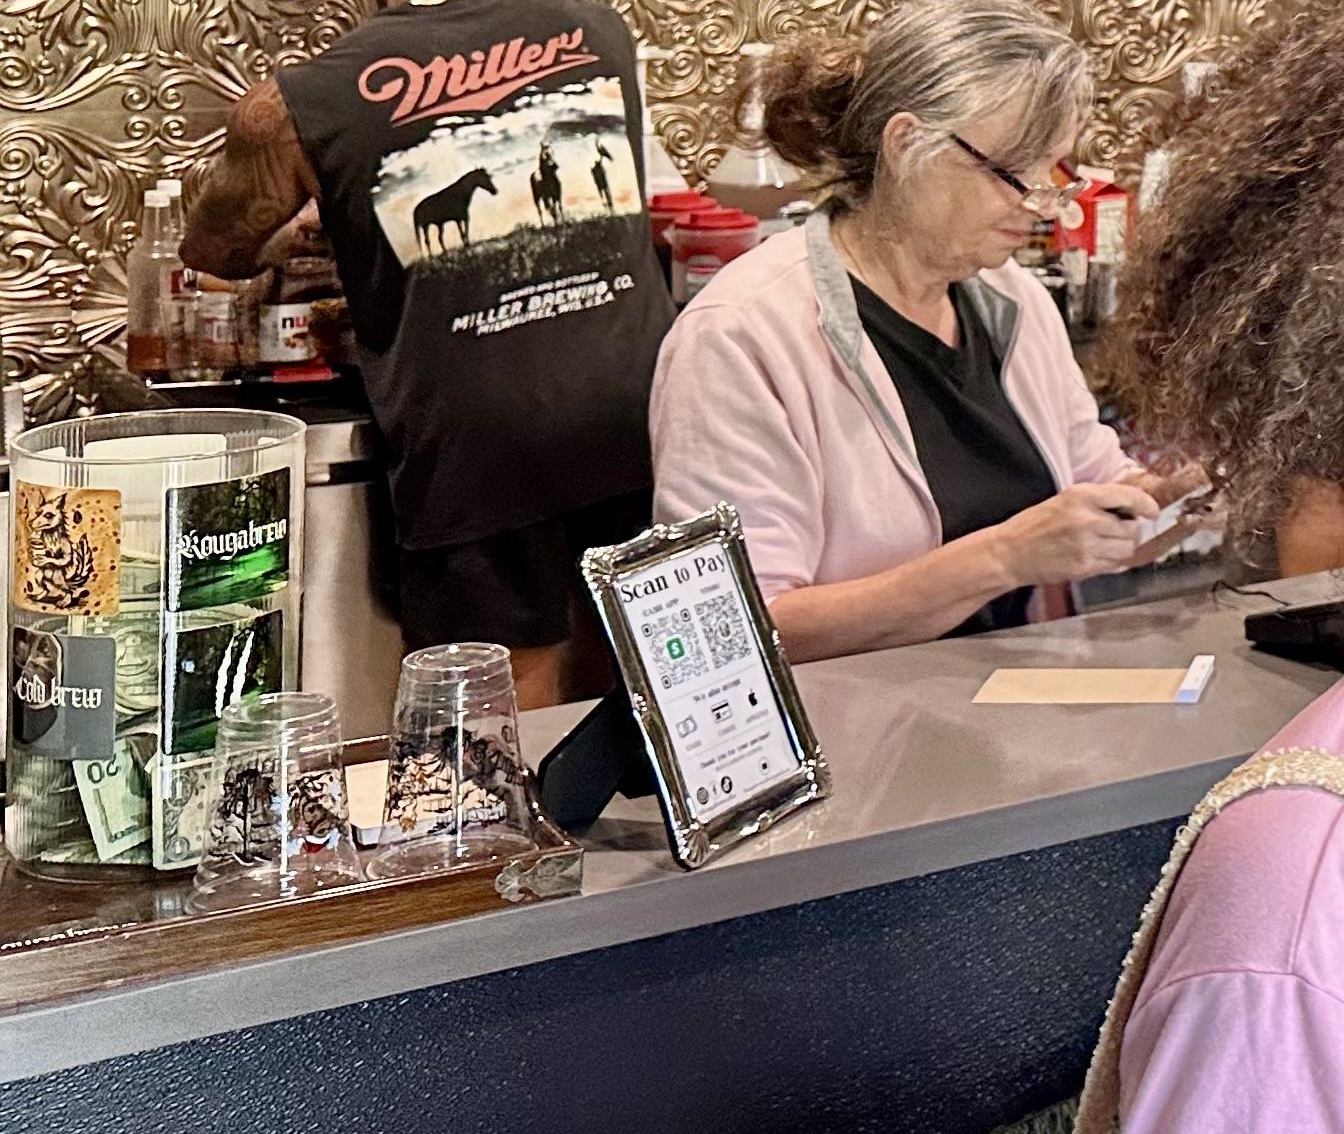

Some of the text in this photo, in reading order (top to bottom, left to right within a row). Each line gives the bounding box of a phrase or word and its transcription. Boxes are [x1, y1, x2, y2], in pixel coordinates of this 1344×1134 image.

[358, 27, 594, 126] Miller
[452, 300, 523, 333] MILLER
[528, 281, 608, 310] BREWING
[620, 574, 669, 604] Scan
[674, 568, 691, 586] to
[693, 551, 726, 577] Pay
[51, 678, 102, 709] brew
